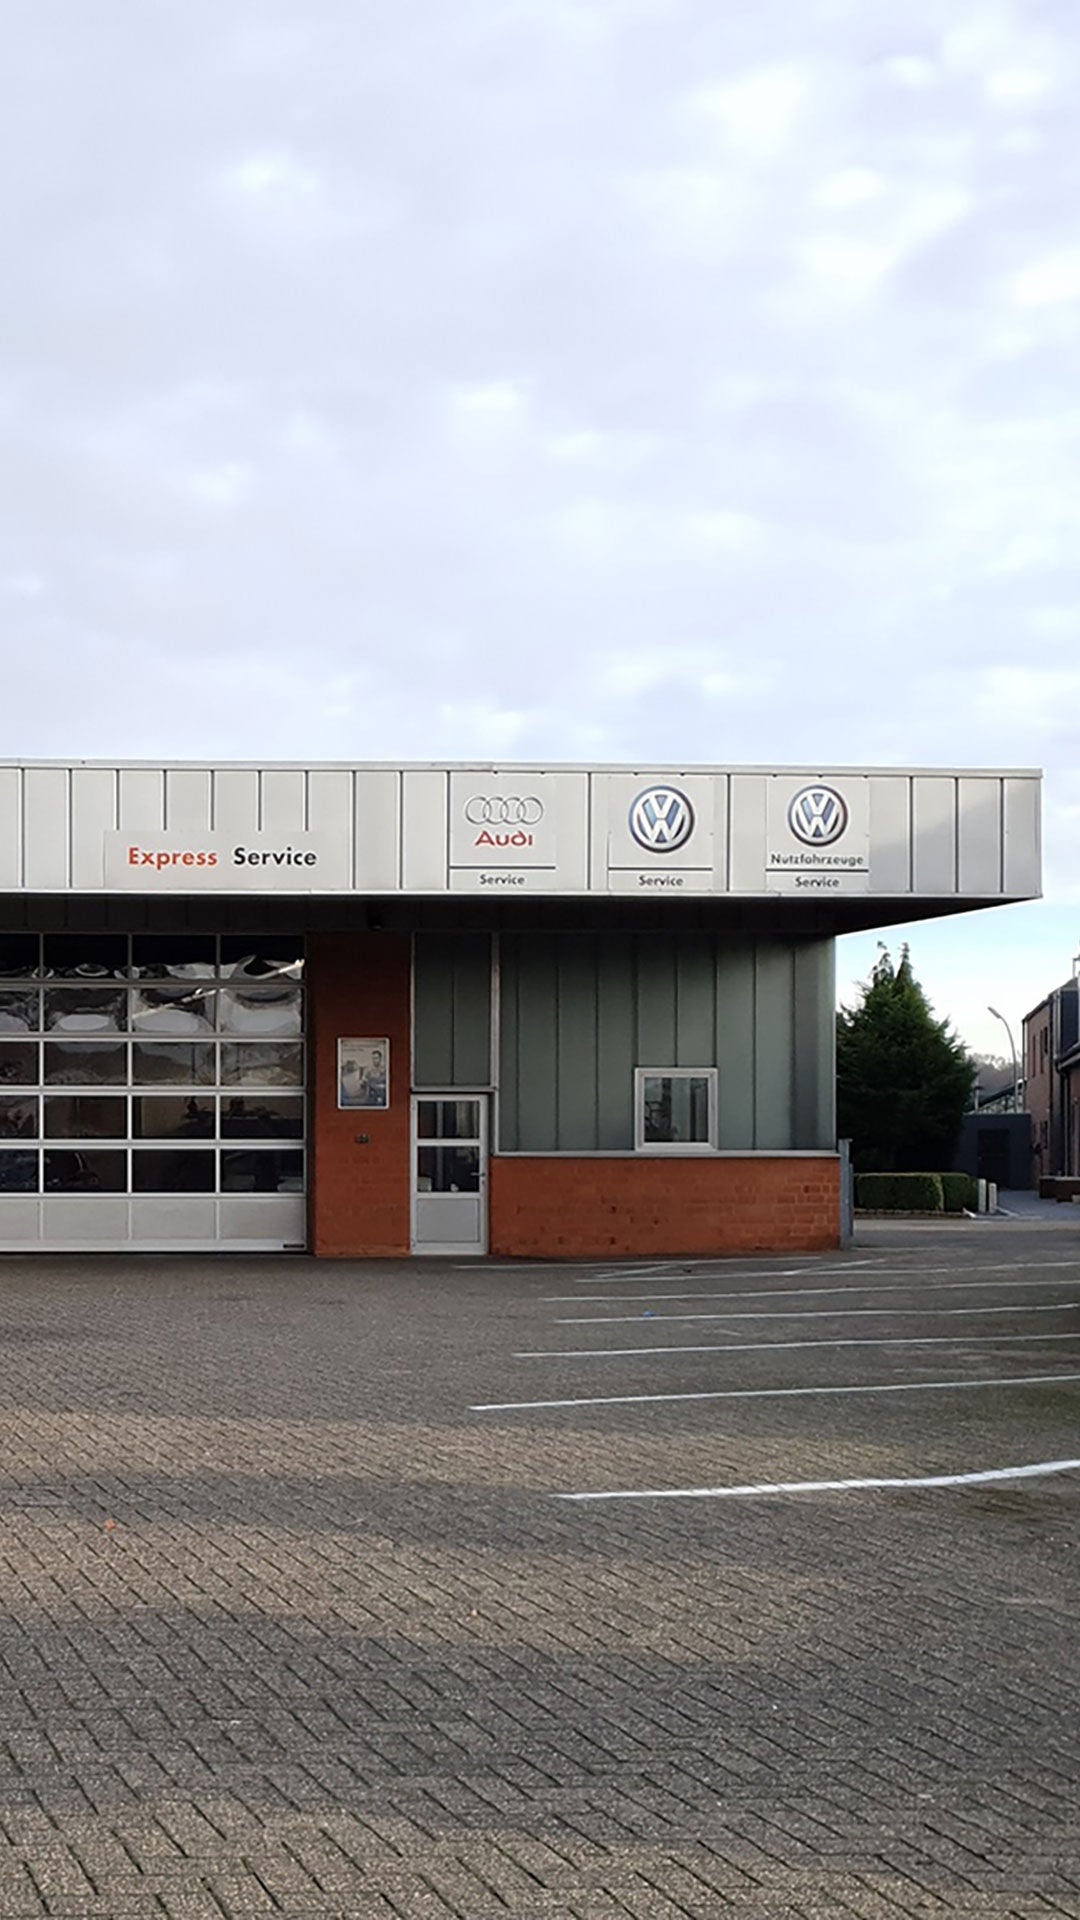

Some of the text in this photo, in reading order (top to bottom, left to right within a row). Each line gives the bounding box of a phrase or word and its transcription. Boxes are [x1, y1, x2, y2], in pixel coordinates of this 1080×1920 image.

[475, 830, 534, 846] Audi
[128, 847, 317, 871] Express Service
[771, 853, 864, 867] Nutzfahrzeuge
[479, 874, 526, 885] Service
[638, 875, 684, 886] Service
[795, 876, 840, 887] Service
